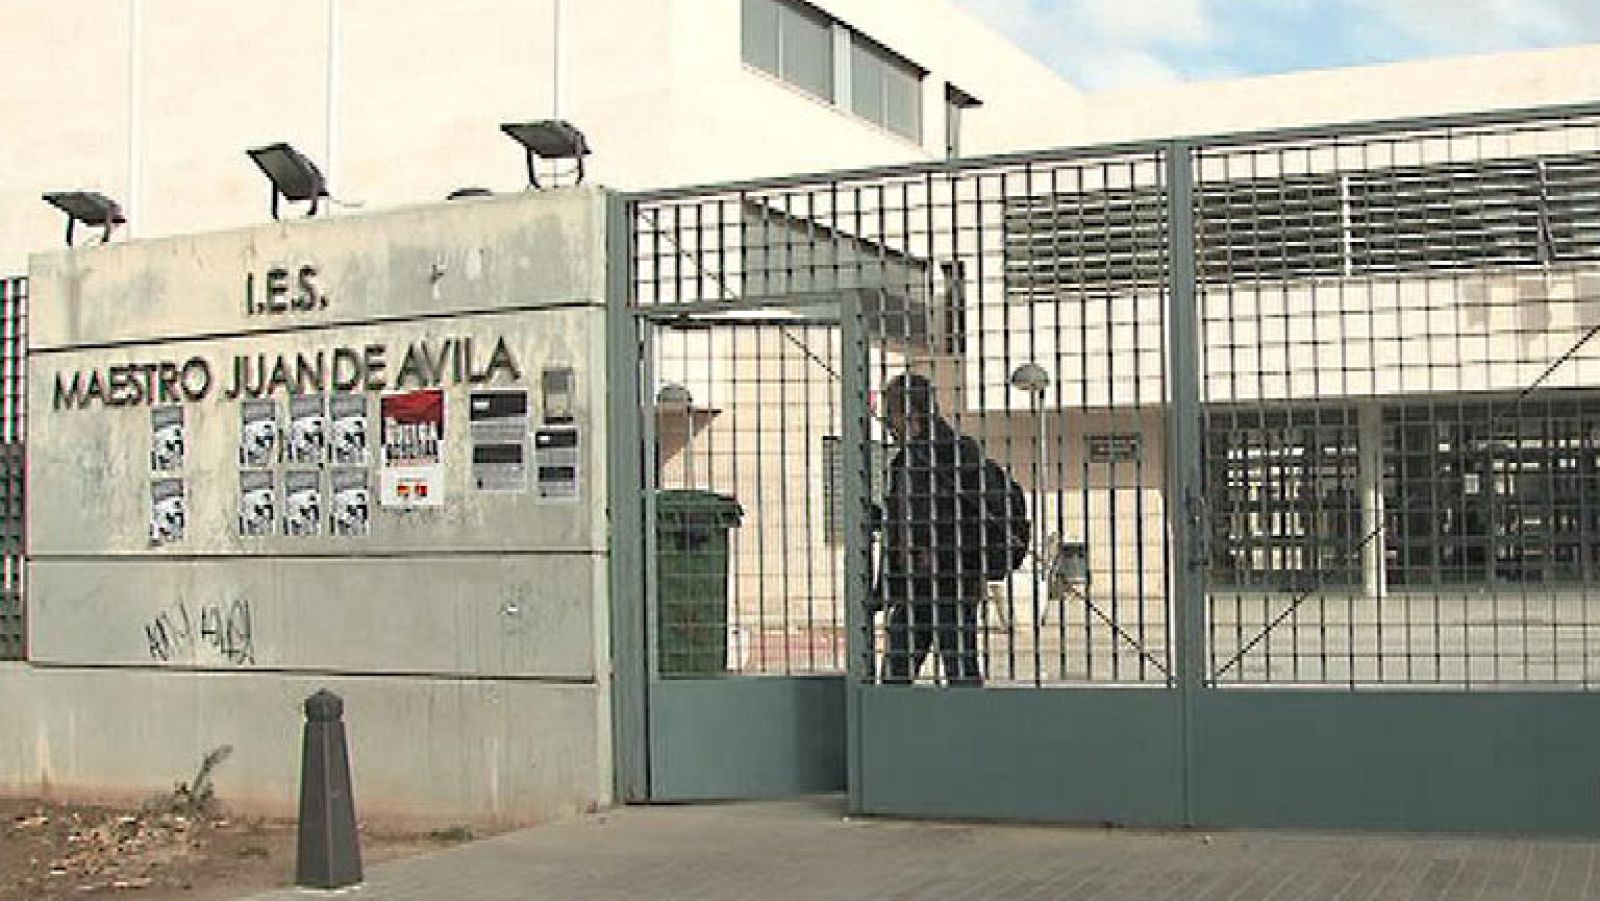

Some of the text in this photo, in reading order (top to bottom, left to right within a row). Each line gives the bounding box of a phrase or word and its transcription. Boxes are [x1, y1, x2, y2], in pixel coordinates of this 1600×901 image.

[246, 265, 328, 316] I.E.S.
[53, 335, 521, 410] MAESTRO JUAN DE AVILA
